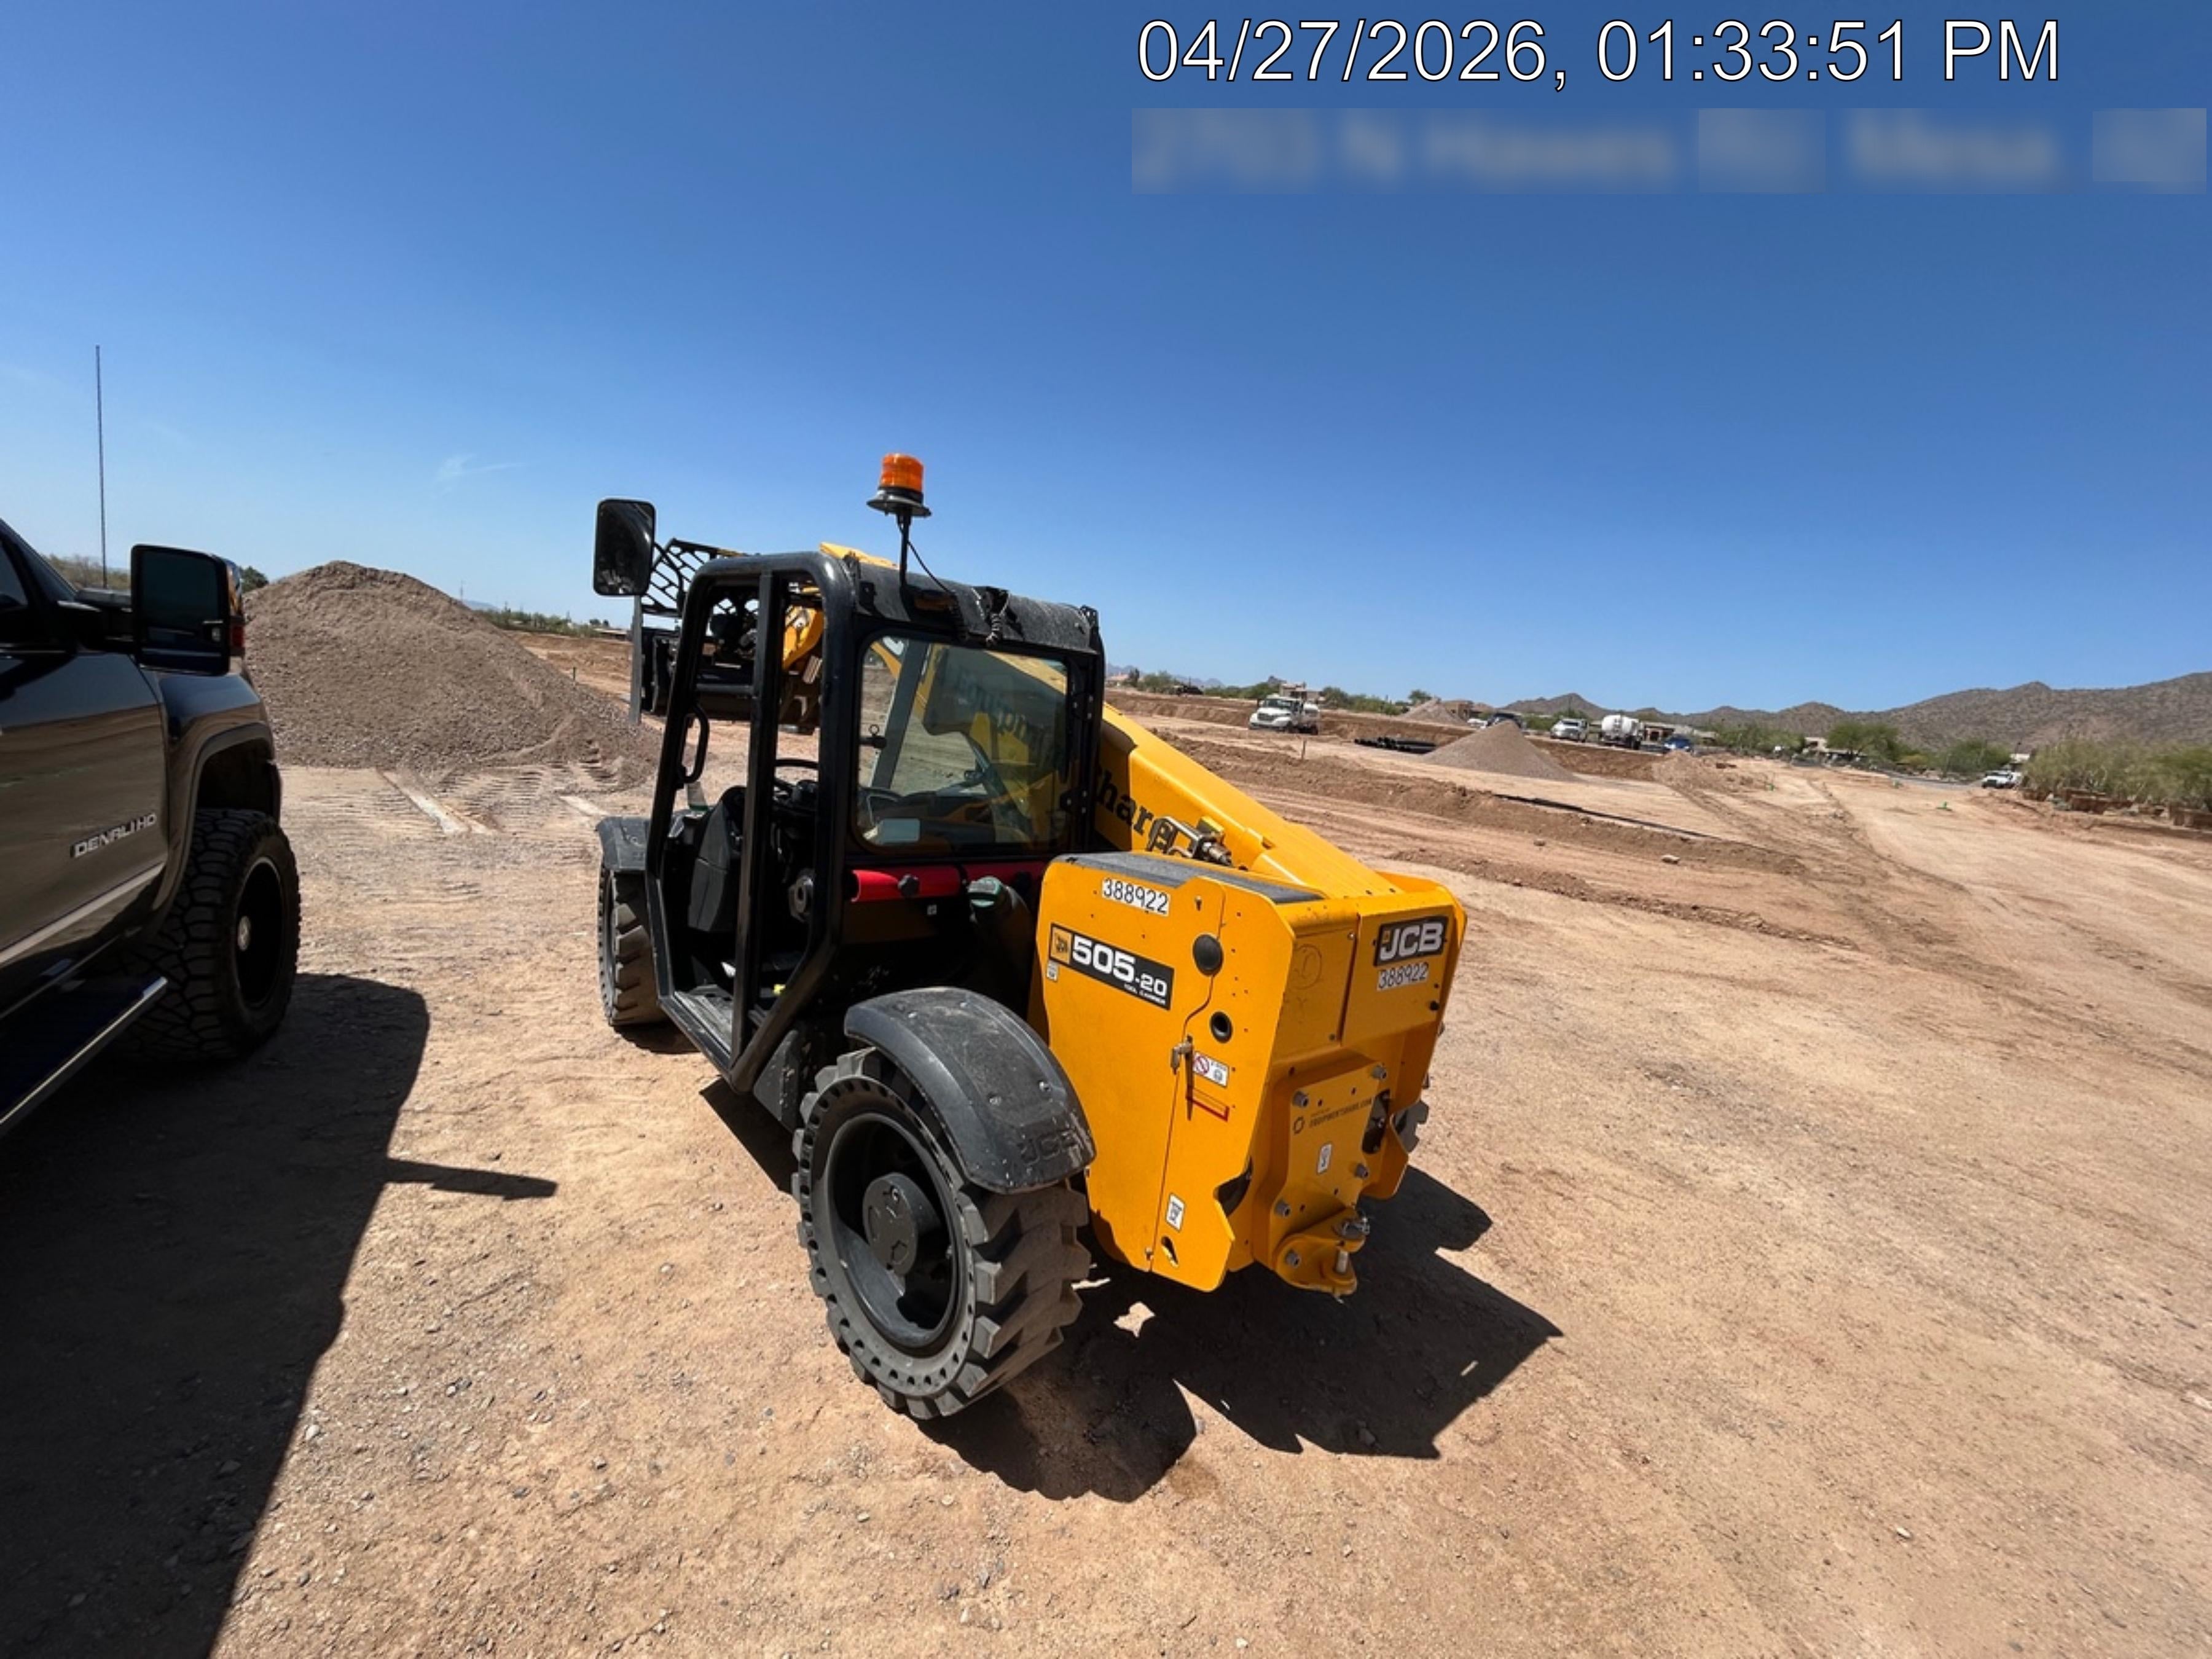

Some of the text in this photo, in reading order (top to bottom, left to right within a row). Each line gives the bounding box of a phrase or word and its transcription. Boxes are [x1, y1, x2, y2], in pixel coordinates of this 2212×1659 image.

[73, 813, 157, 858] DENALI HD
[1102, 877, 1169, 915] 388922
[1379, 922, 1443, 961] JCB
[1378, 962, 1429, 989] 388922
